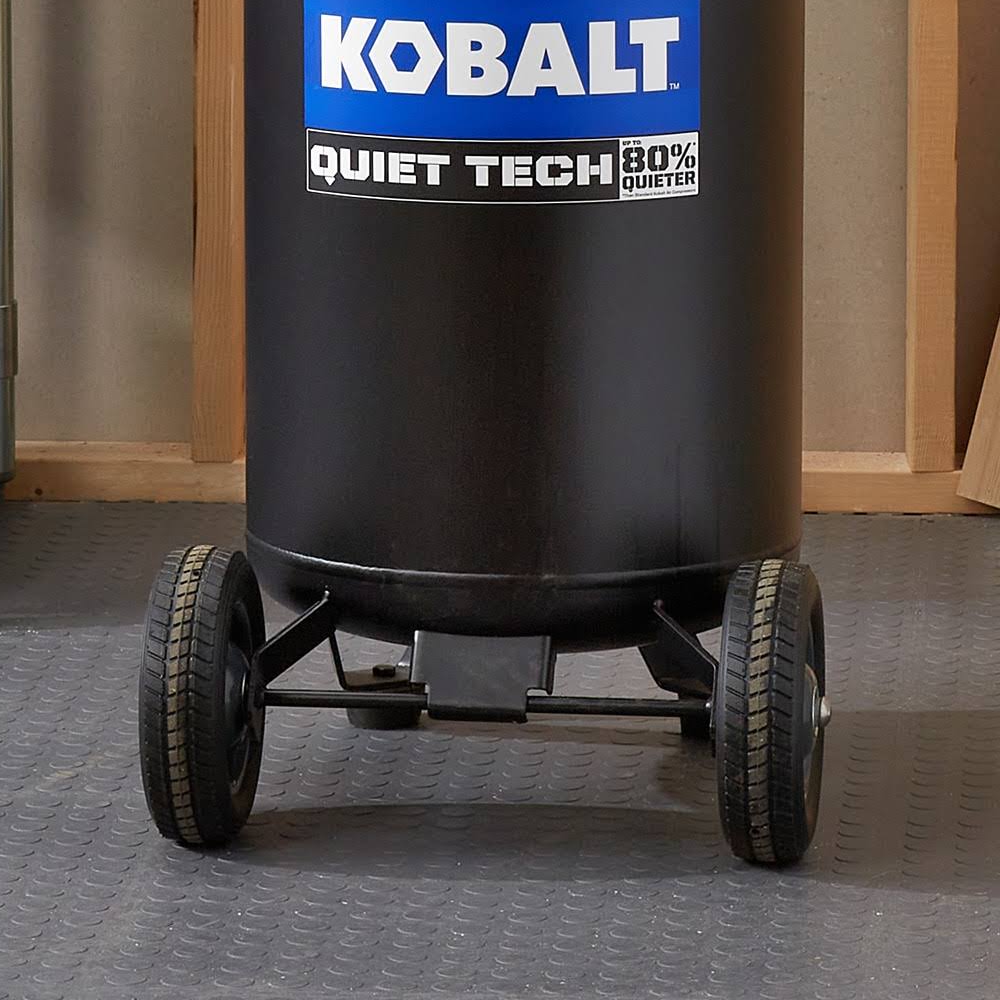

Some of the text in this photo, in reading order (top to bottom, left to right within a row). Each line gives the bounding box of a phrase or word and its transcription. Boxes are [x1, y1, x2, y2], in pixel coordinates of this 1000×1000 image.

[320, 14, 680, 97] KOBALT
[310, 144, 614, 187] QUIET TECH
[622, 171, 696, 192] QUIETER
